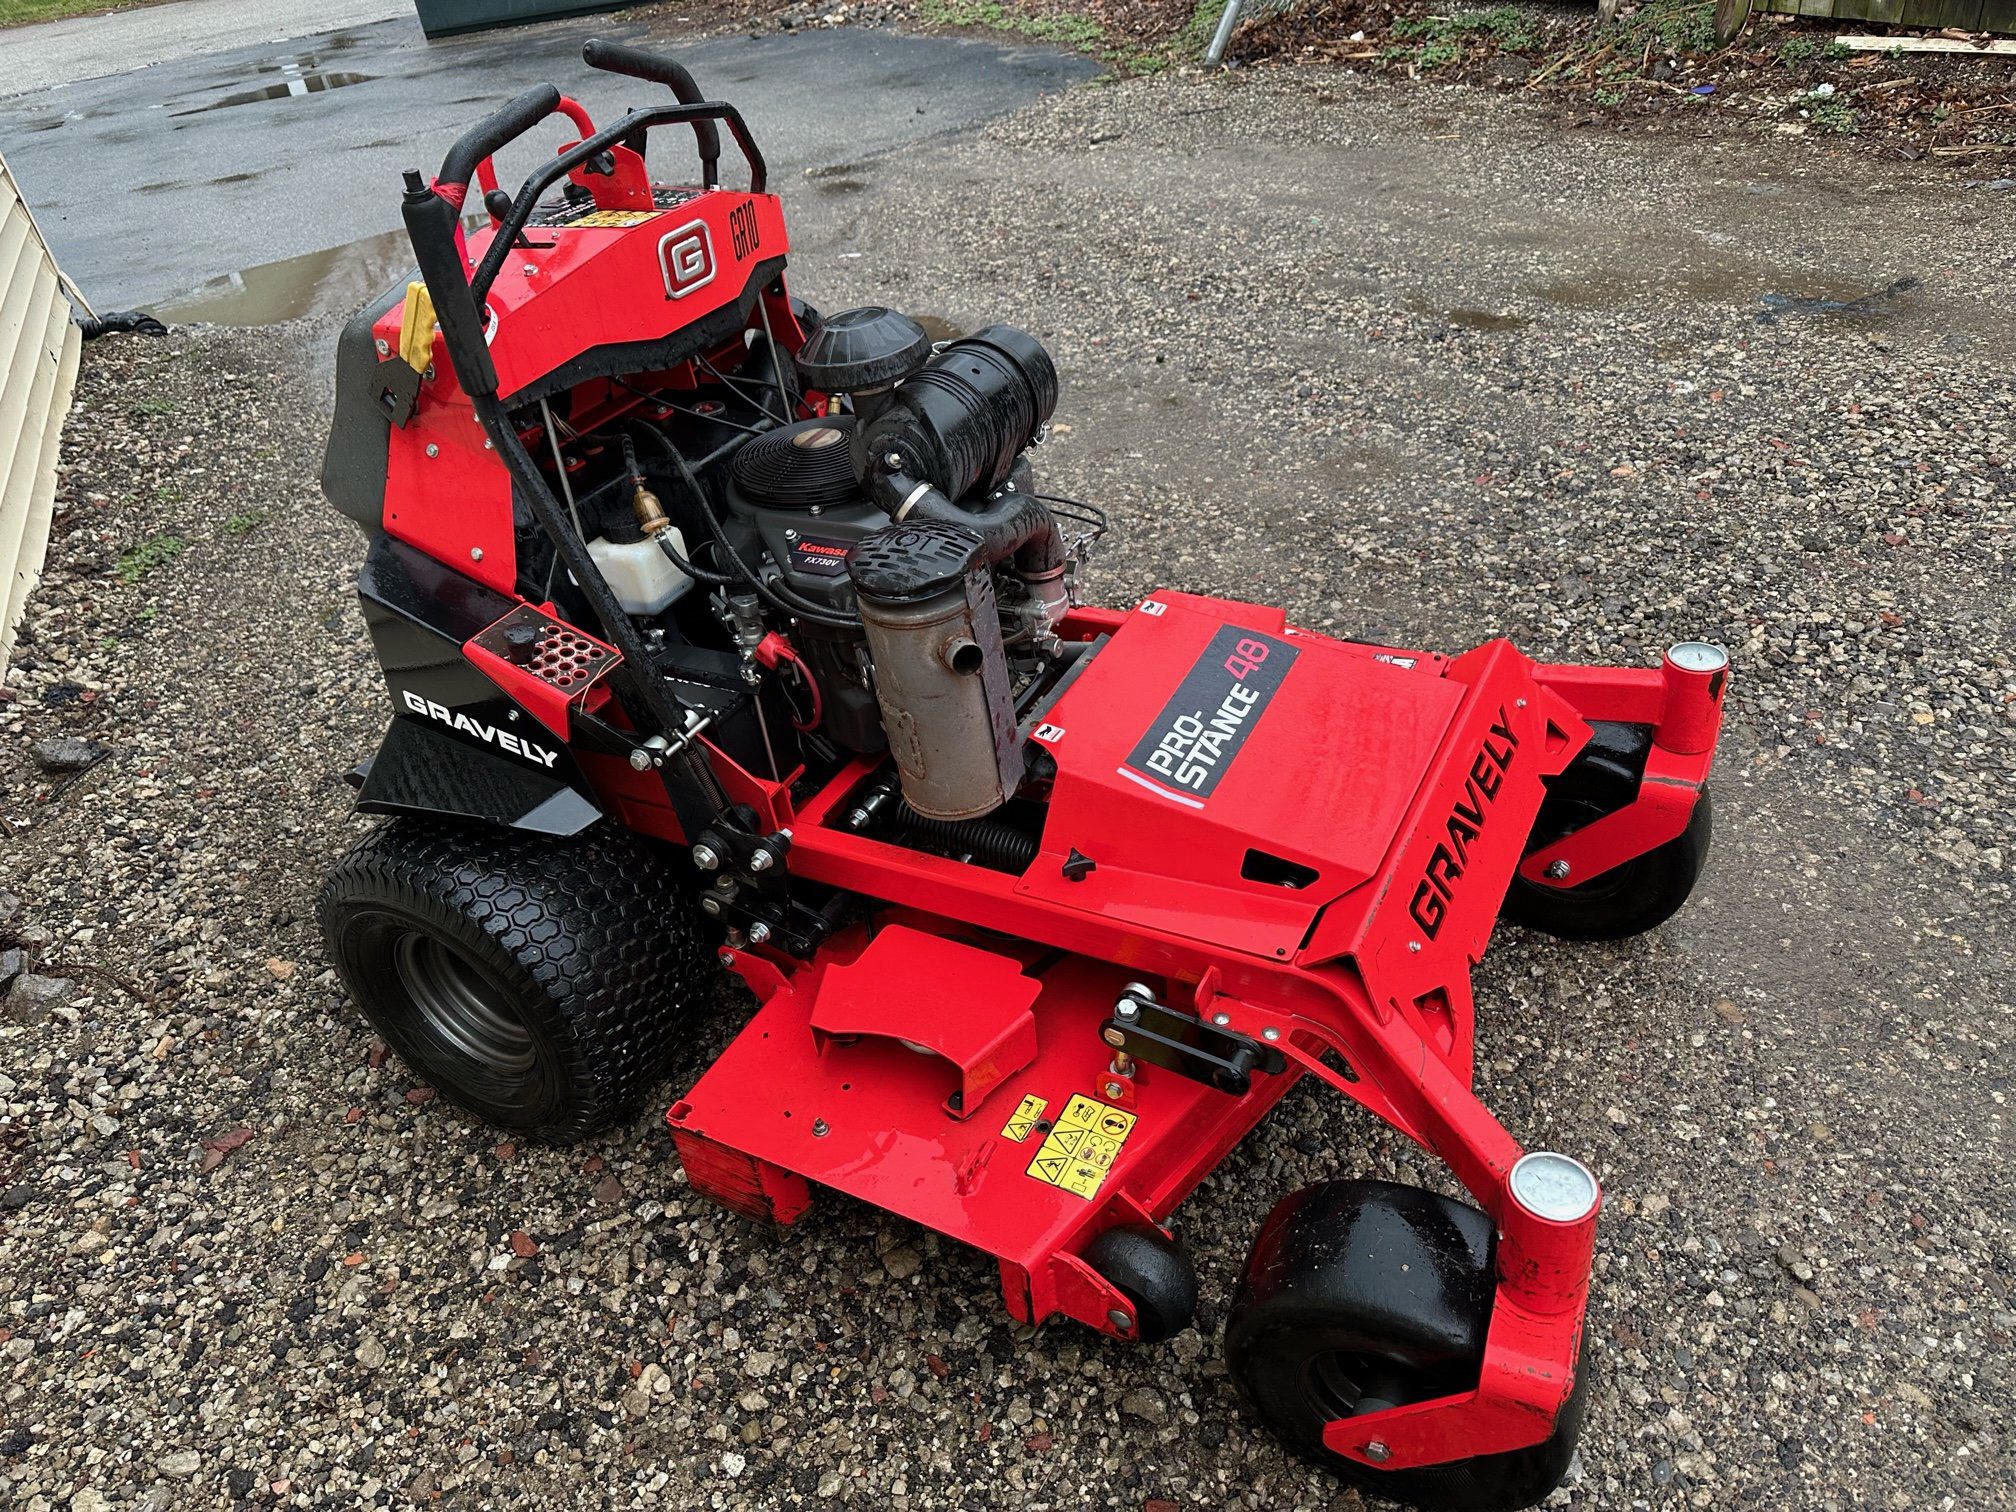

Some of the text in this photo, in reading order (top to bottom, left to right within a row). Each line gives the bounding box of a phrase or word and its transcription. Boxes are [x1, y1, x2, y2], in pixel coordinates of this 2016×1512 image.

[729, 199, 760, 262] GR10
[798, 542, 849, 558] Kawasa
[804, 556, 840, 567] FX730V
[402, 690, 558, 769] GRAVELY
[1145, 710, 1203, 777] PRO-
[1173, 638, 1270, 790] STANCE 48
[1408, 703, 1520, 942] GRAVELY
